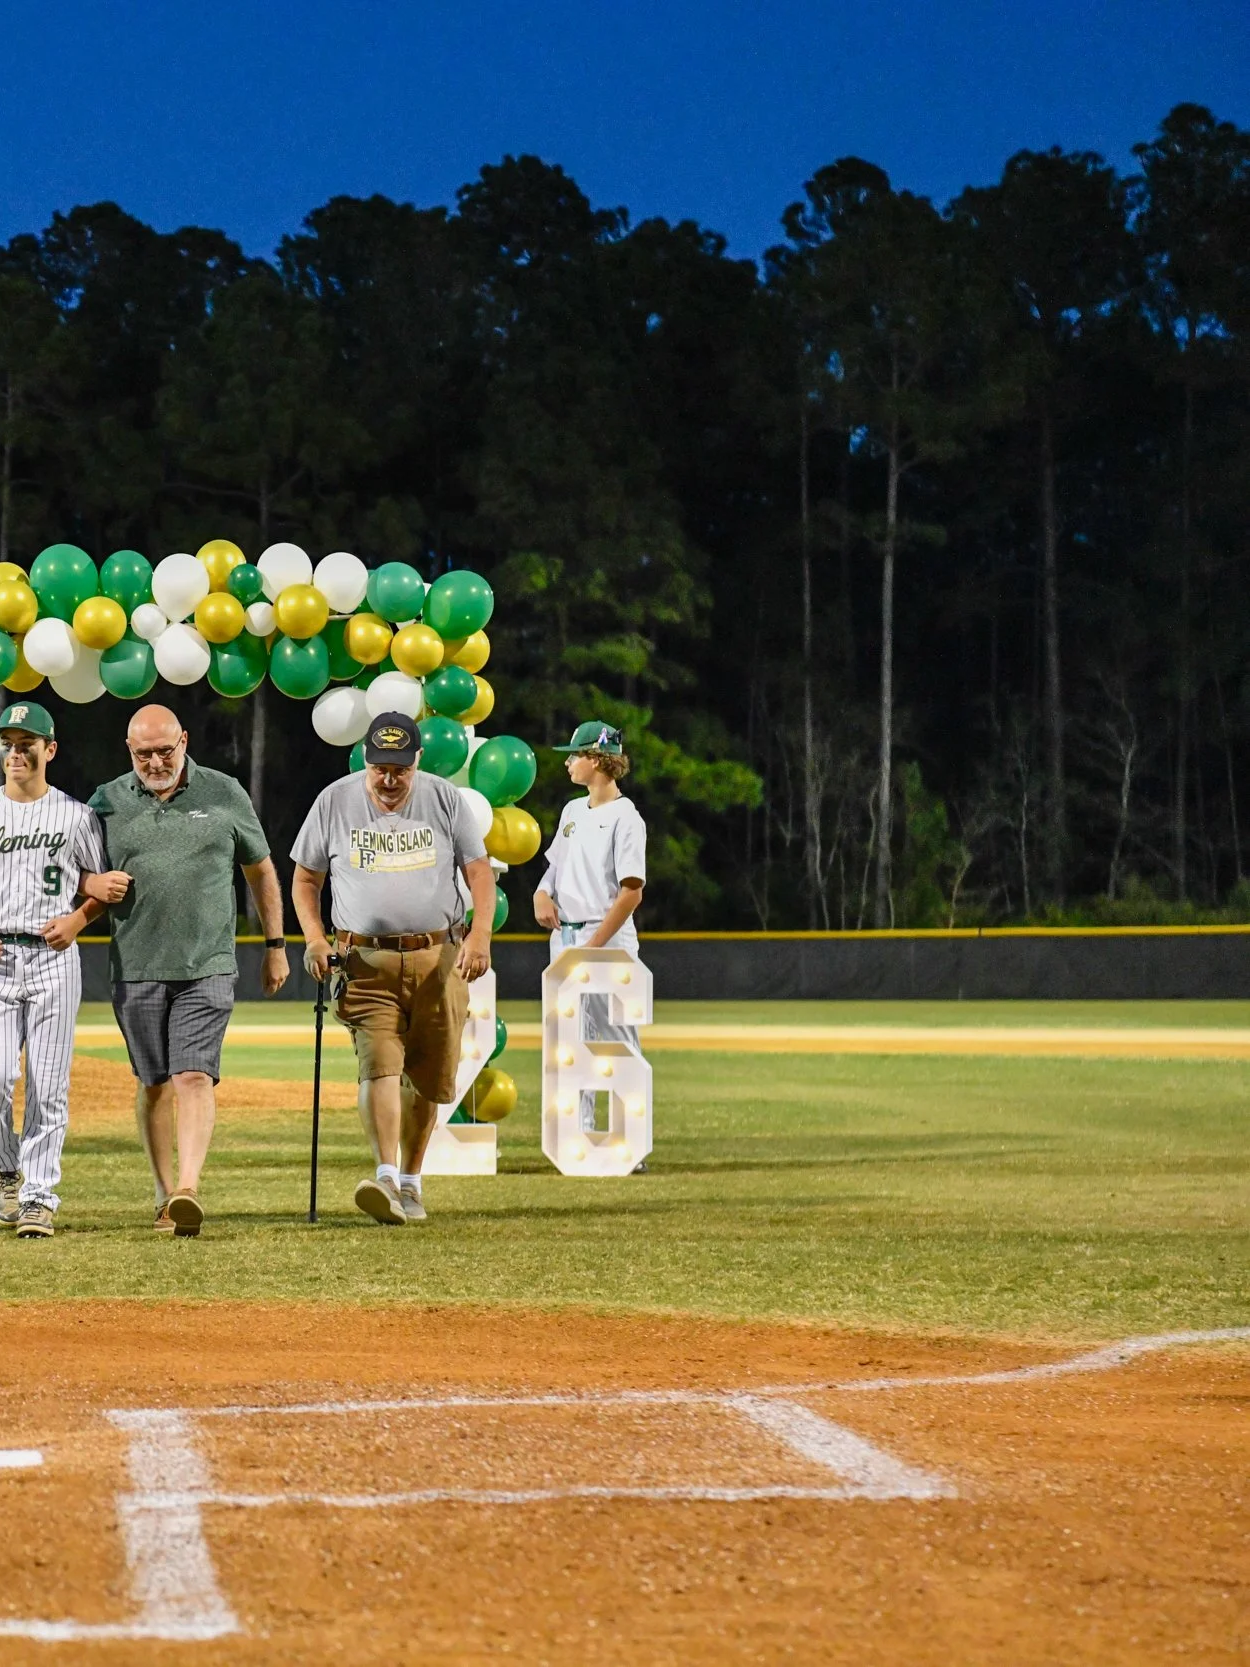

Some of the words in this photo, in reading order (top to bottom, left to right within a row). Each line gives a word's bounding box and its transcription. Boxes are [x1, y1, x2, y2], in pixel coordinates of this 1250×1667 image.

[350, 829, 394, 853] FLEMING
[396, 828, 433, 853] ISLAND
[43, 865, 61, 896] 9
